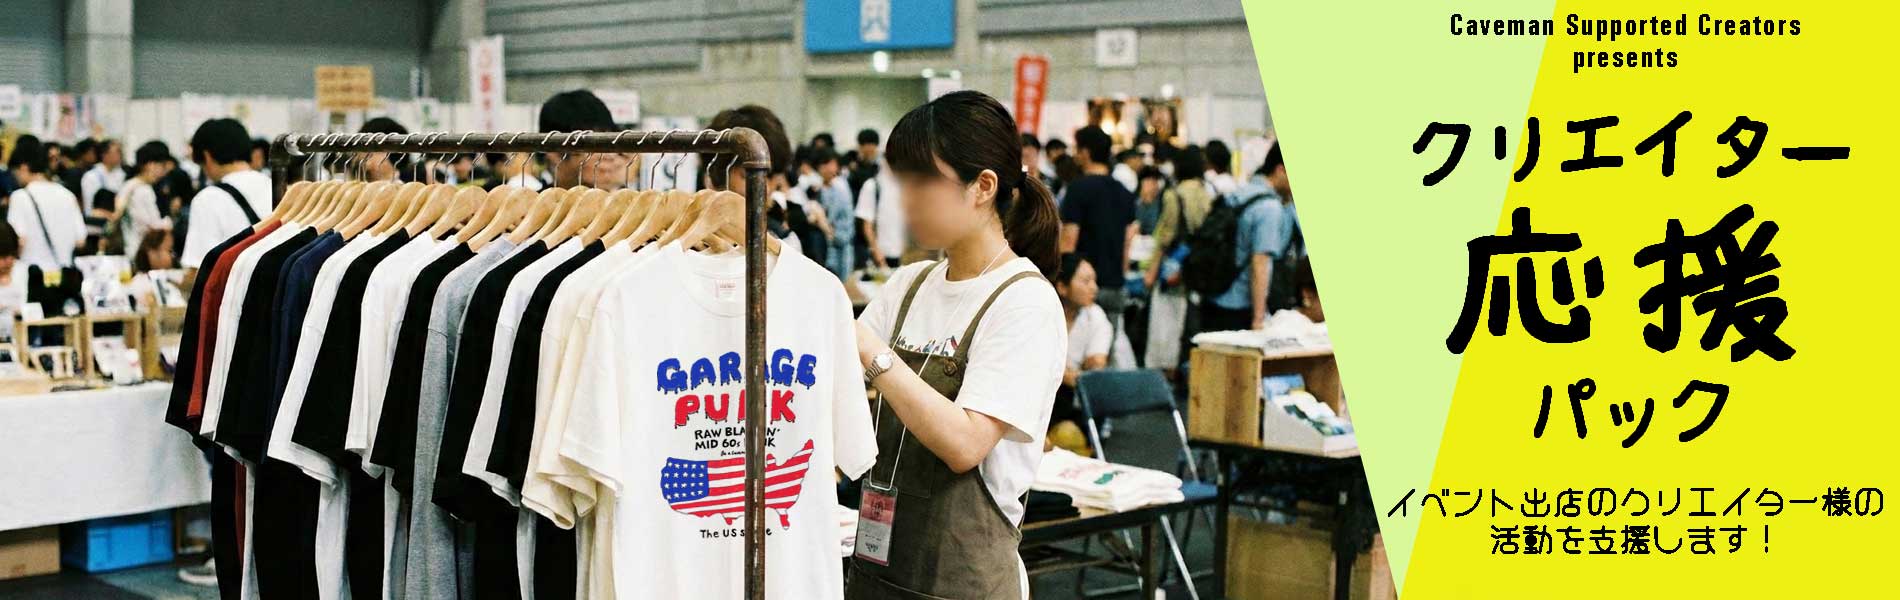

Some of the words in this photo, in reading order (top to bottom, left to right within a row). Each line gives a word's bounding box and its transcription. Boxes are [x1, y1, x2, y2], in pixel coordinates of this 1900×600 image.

[657, 348, 817, 394] GARGE
[674, 388, 796, 429] PUK
[694, 428, 722, 440] RAW
[694, 438, 719, 451] MID
[700, 529, 720, 539] The
[722, 528, 737, 538] US
